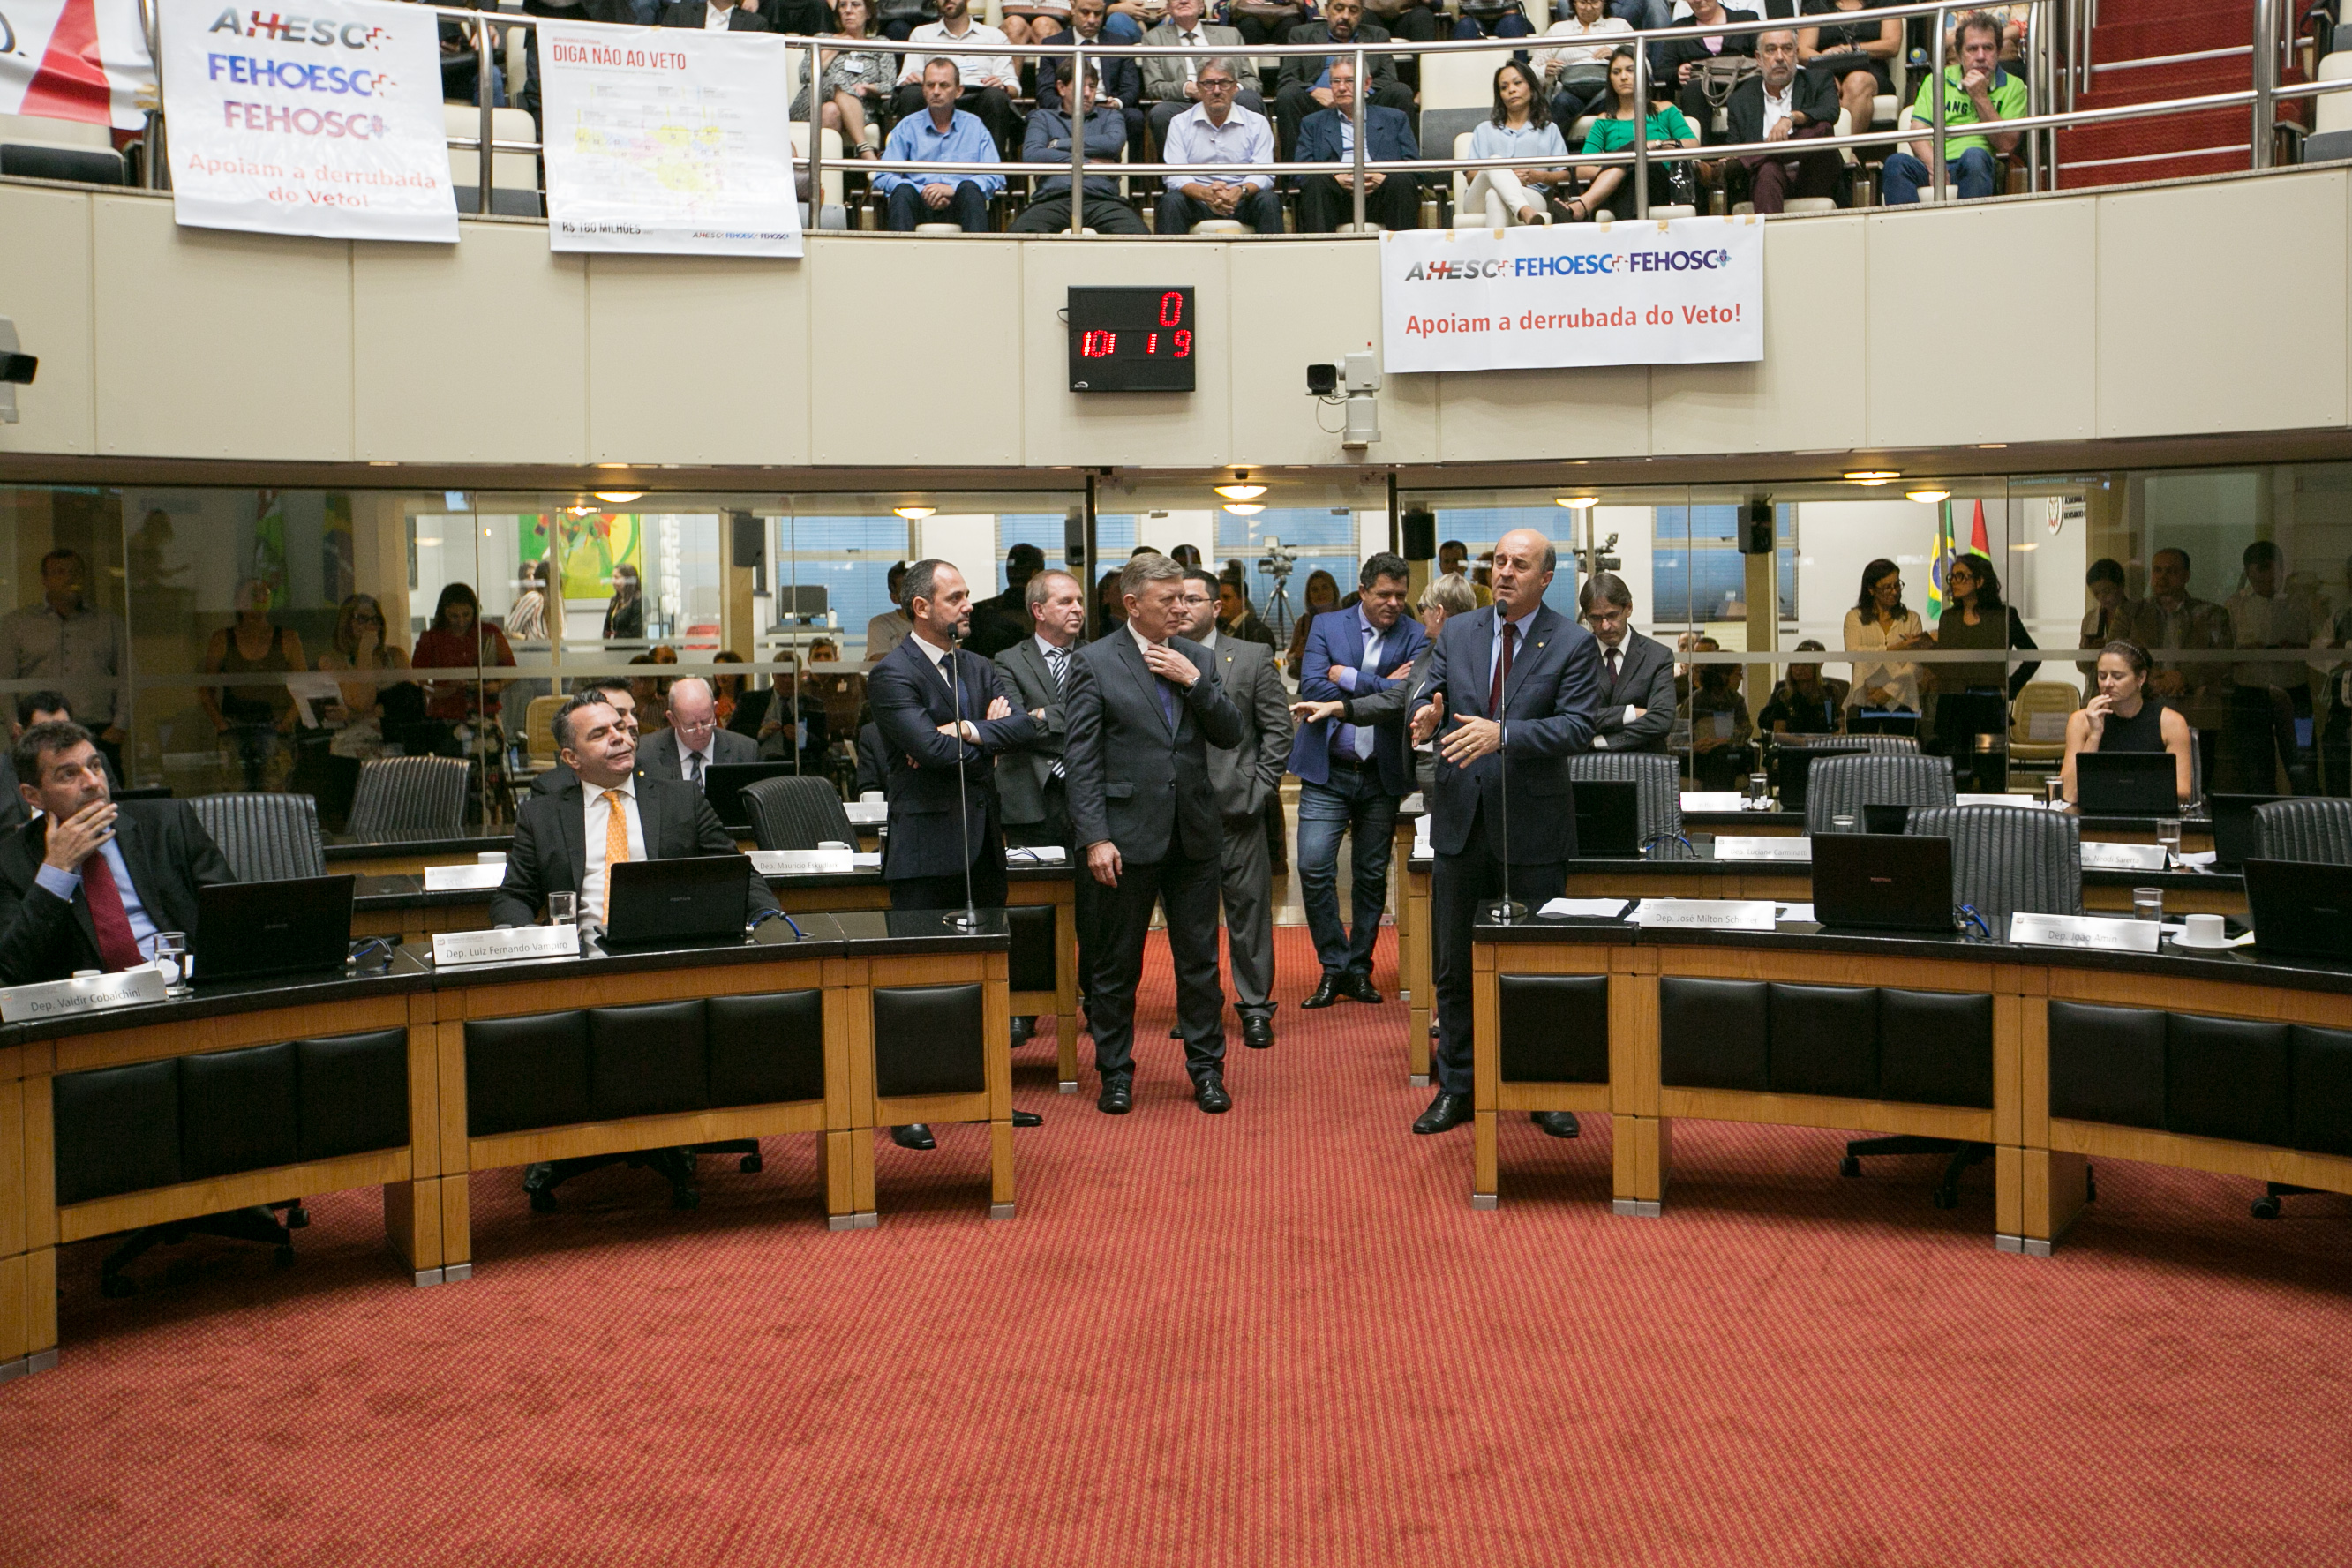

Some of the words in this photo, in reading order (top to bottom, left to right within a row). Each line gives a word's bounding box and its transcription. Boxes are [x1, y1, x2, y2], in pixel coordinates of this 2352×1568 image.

[208, 6, 367, 49] AHESC
[553, 44, 588, 64] DIGA
[592, 46, 621, 65] NÃO
[627, 50, 645, 67] AO
[650, 51, 686, 70] VETO
[207, 52, 372, 96] FEHOESC
[223, 100, 369, 139] FEHOSC
[188, 154, 283, 177] Apoiam
[293, 167, 305, 180] a
[315, 164, 437, 189] derrubada
[268, 186, 299, 204] do
[306, 190, 369, 207] Veto!
[1405, 259, 1499, 281] AHESC
[1515, 253, 1613, 277] FEHOESC
[1630, 249, 1718, 273] FEHOSC
[1158, 291, 1183, 327] 0
[1405, 312, 1491, 339] Apoiam
[1499, 317, 1511, 331] a
[1519, 306, 1637, 330] derrubada
[1645, 304, 1674, 325] do
[1681, 303, 1741, 325] Veto!
[1656, 914, 1674, 923] Dep.
[1676, 913, 1694, 922] José
[1696, 914, 1723, 923] Milton
[447, 949, 468, 959] Dep.
[470, 948, 487, 957] Luiz
[489, 944, 530, 955] Fernando
[531, 942, 568, 950] Vampiro
[2048, 930, 2069, 941] Dep.
[2070, 932, 2091, 942] João
[2093, 934, 2117, 942] Amin
[30, 1001, 56, 1013] Dep.
[56, 995, 87, 1008] Valdir
[89, 987, 141, 1004] Cobalchini
